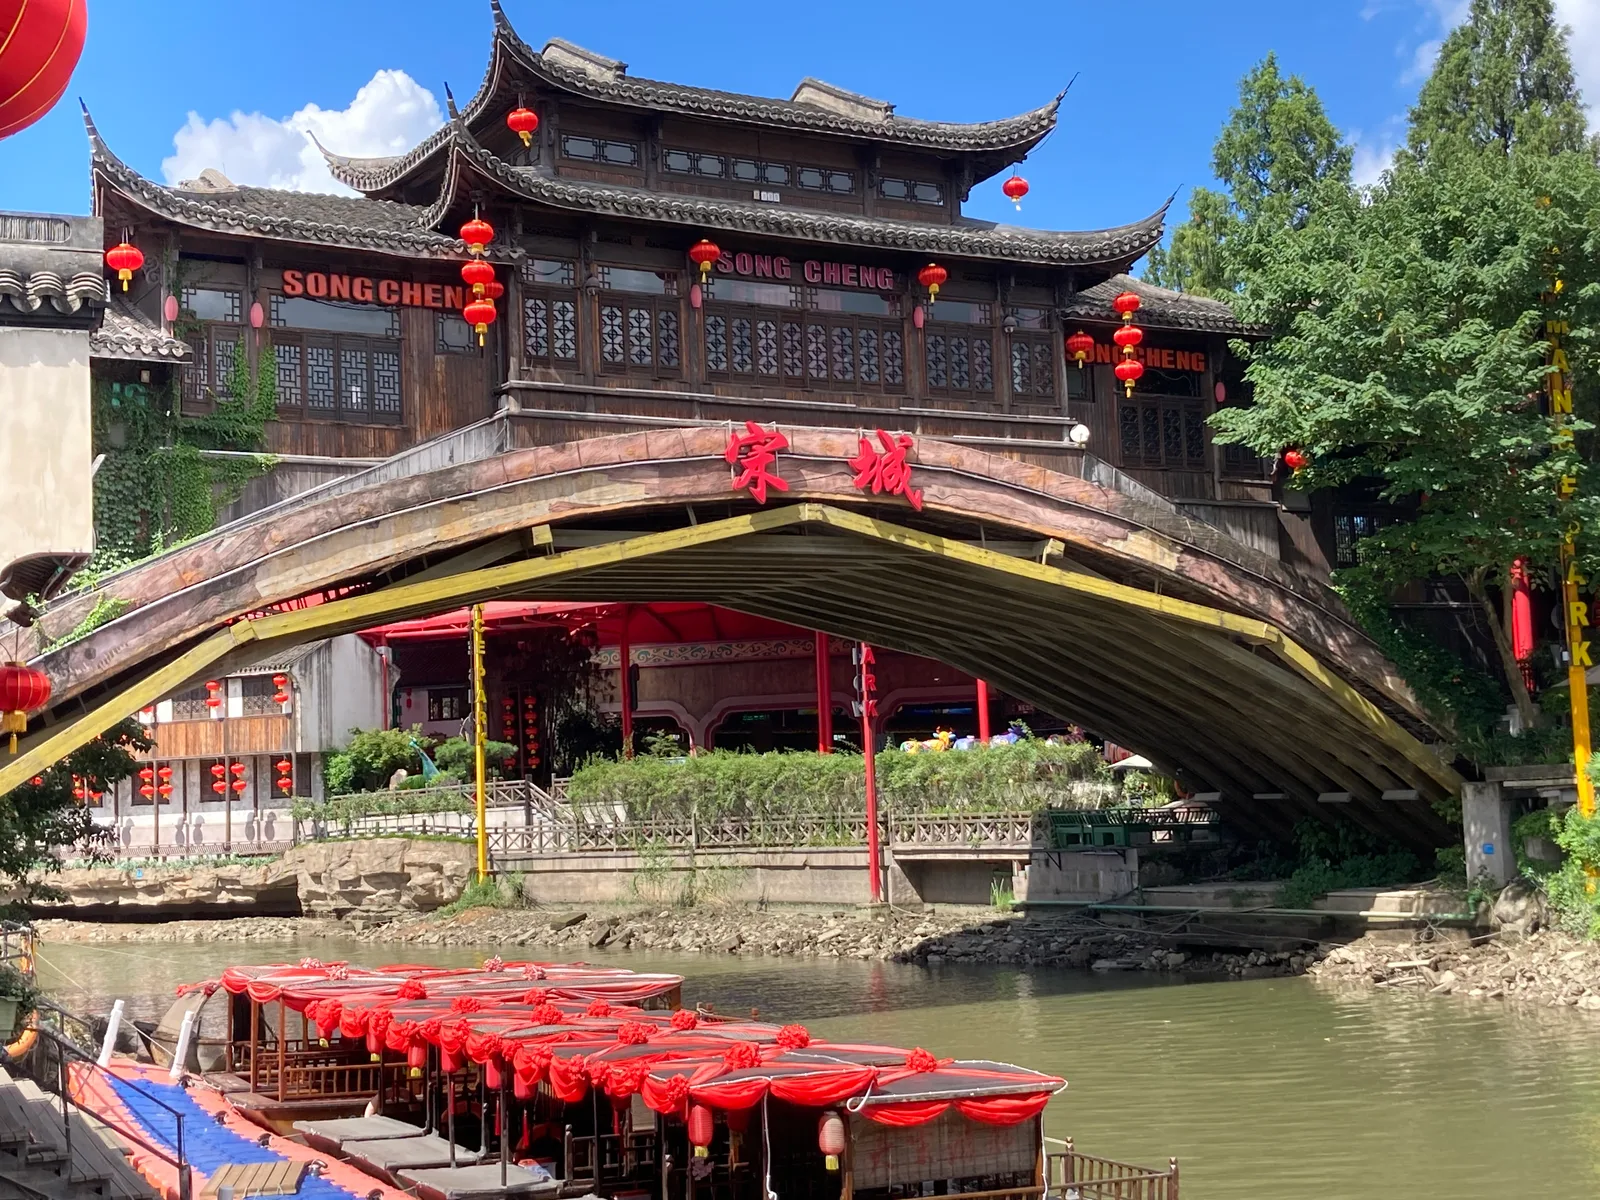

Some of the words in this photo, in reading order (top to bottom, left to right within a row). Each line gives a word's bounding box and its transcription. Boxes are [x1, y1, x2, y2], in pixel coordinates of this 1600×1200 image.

[282, 270, 373, 301] SONG
[715, 250, 791, 279] SONG
[804, 260, 894, 290] CHENG
[1066, 341, 1129, 364] ONG
[725, 420, 923, 512] 宋城
